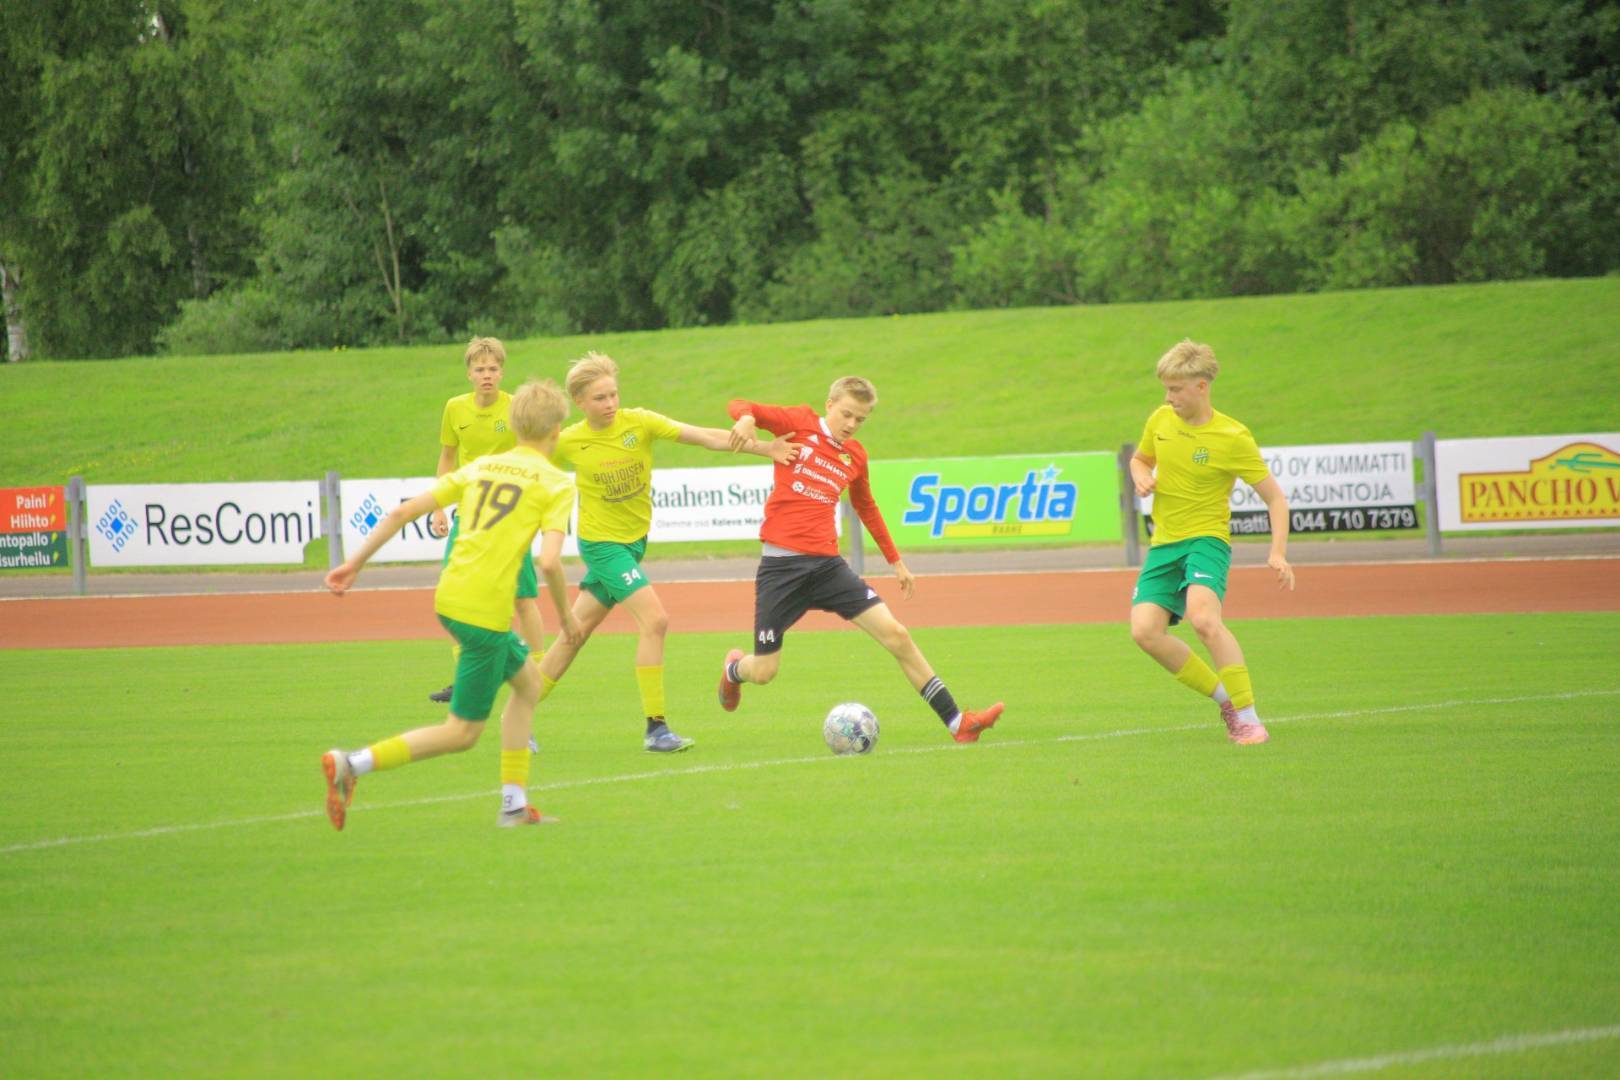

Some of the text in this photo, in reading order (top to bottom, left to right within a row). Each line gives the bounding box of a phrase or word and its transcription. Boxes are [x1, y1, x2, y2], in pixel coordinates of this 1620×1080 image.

[1289, 456, 1311, 476] OY
[1316, 453, 1406, 475] KUMMATTI
[16, 493, 46, 509] Paini
[728, 483, 773, 506] Seu
[904, 463, 1077, 537] Sportia
[1470, 477, 1597, 507] PANCHO
[469, 480, 523, 530] 19
[10, 512, 49, 529] Hiihto
[145, 501, 313, 545] ResComi
[1292, 513, 1325, 532] 044
[1330, 510, 1364, 530] 710
[1368, 508, 1415, 528] 7379
[622, 568, 641, 586] 34
[758, 629, 775, 645] 44
